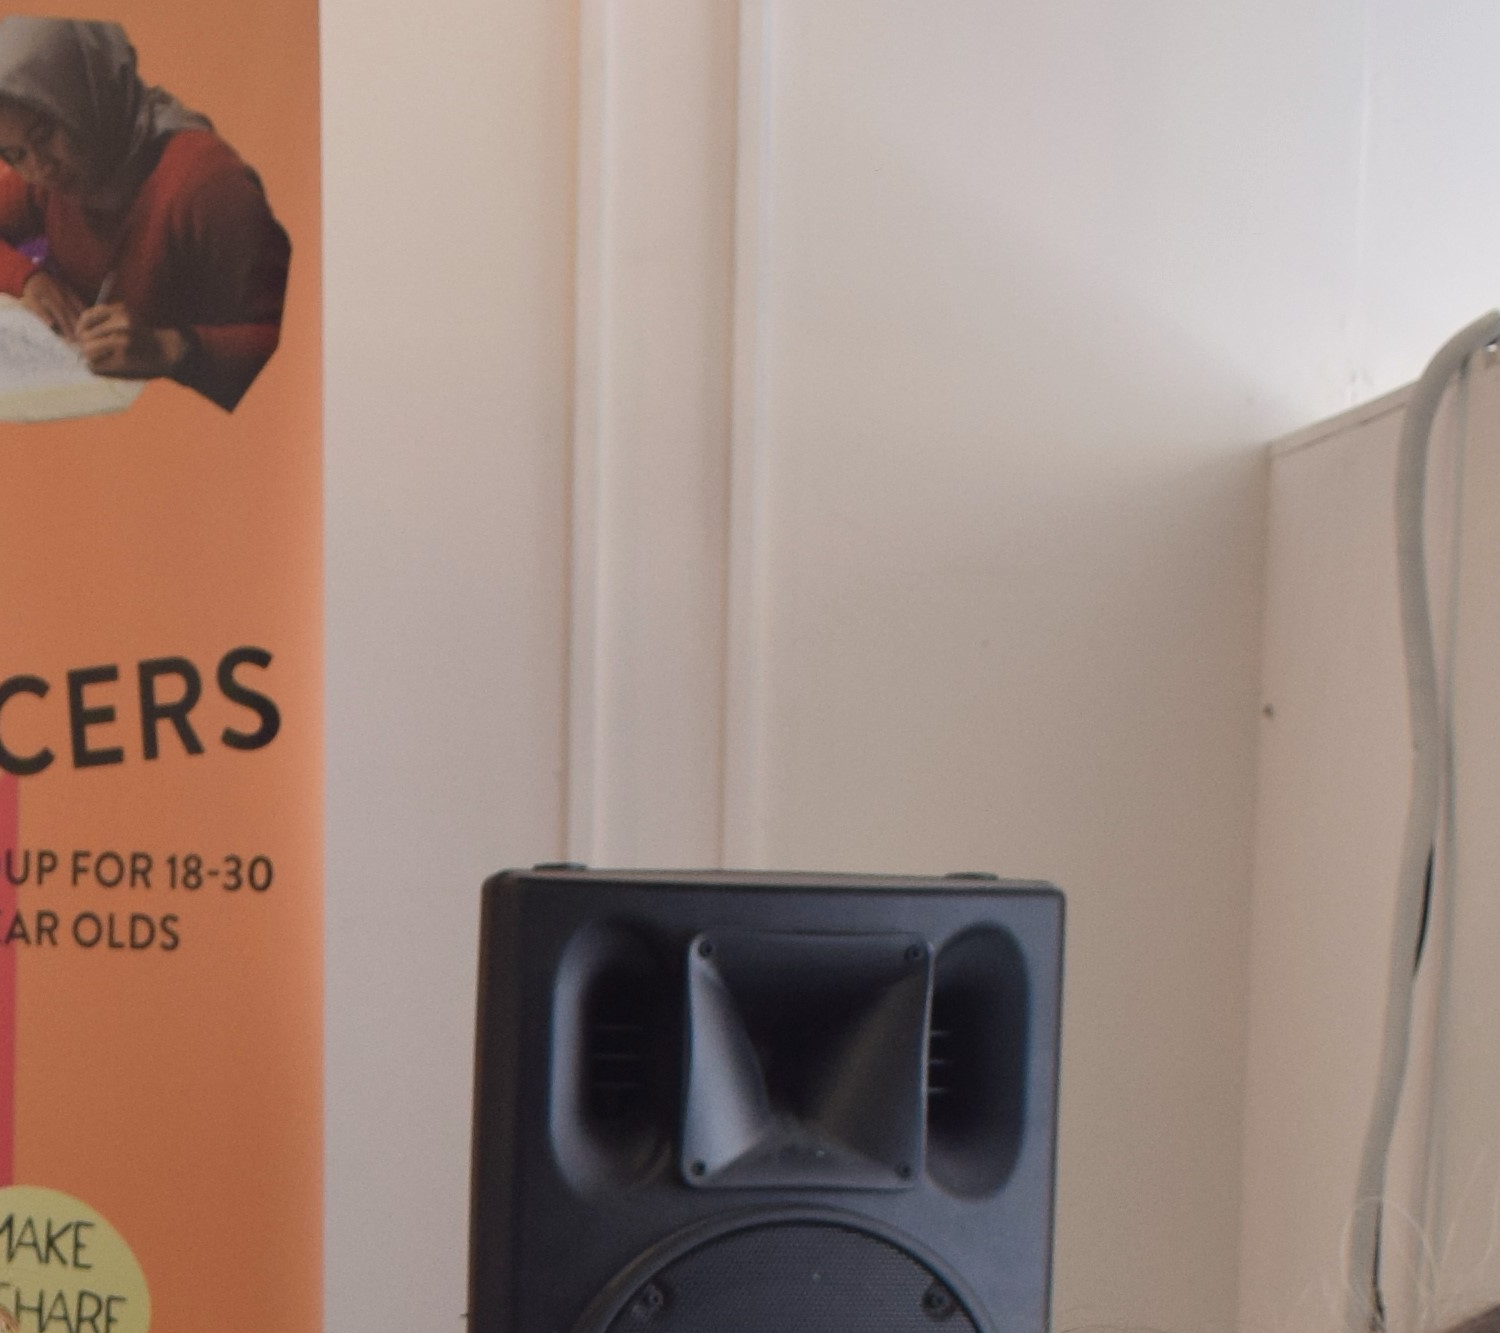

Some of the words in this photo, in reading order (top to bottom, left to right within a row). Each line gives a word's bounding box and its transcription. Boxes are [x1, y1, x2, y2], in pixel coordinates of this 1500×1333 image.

[71, 852, 154, 890] FOR
[164, 854, 276, 894] 18-30
[71, 911, 182, 952] OLDS
